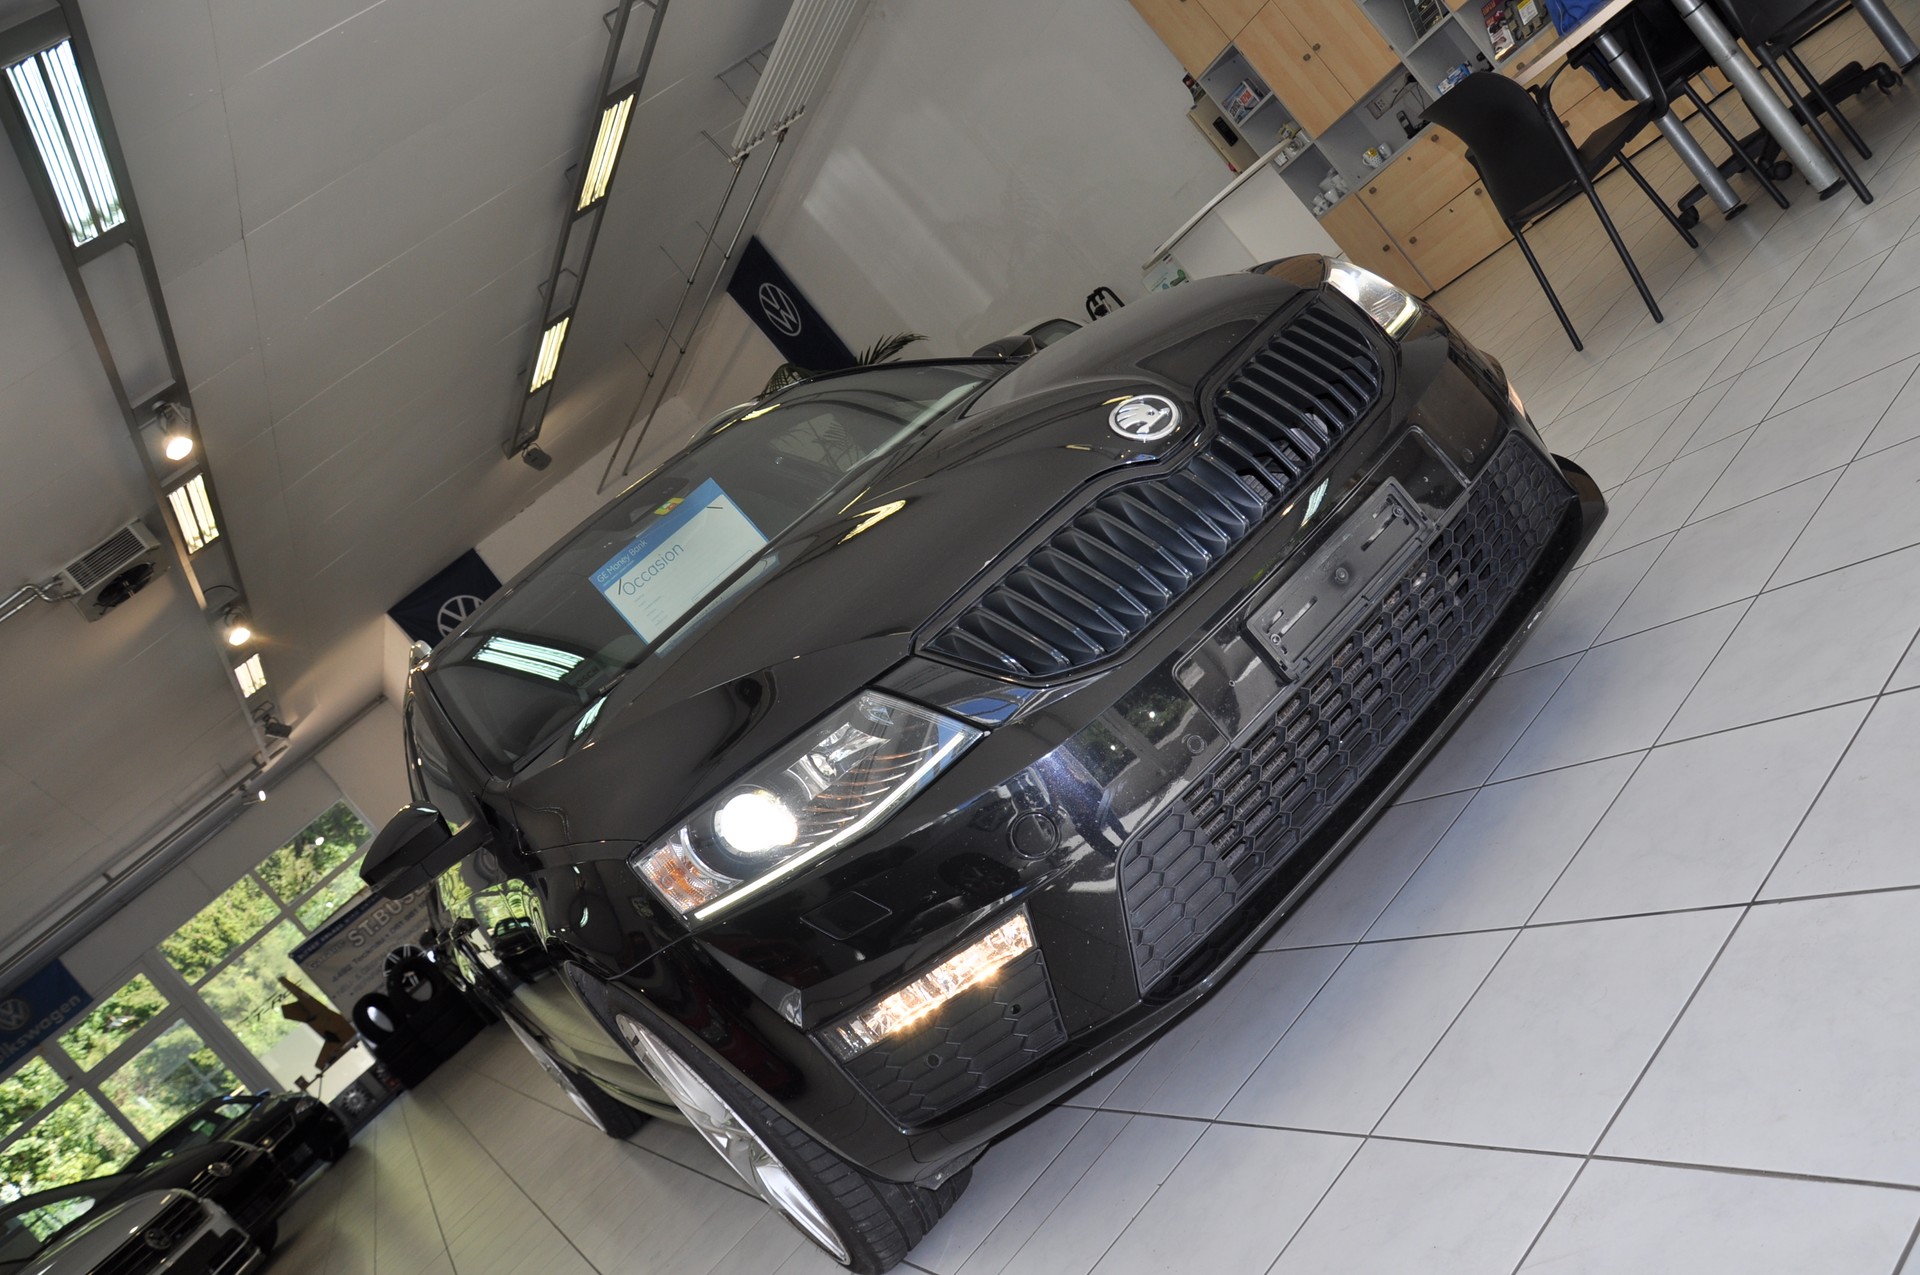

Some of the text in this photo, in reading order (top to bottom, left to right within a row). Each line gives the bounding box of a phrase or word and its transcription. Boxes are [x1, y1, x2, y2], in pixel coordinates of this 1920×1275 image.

[597, 571, 609, 584] GE
[608, 553, 631, 577] Money
[628, 538, 648, 556] Bank
[622, 543, 685, 596] Occasion
